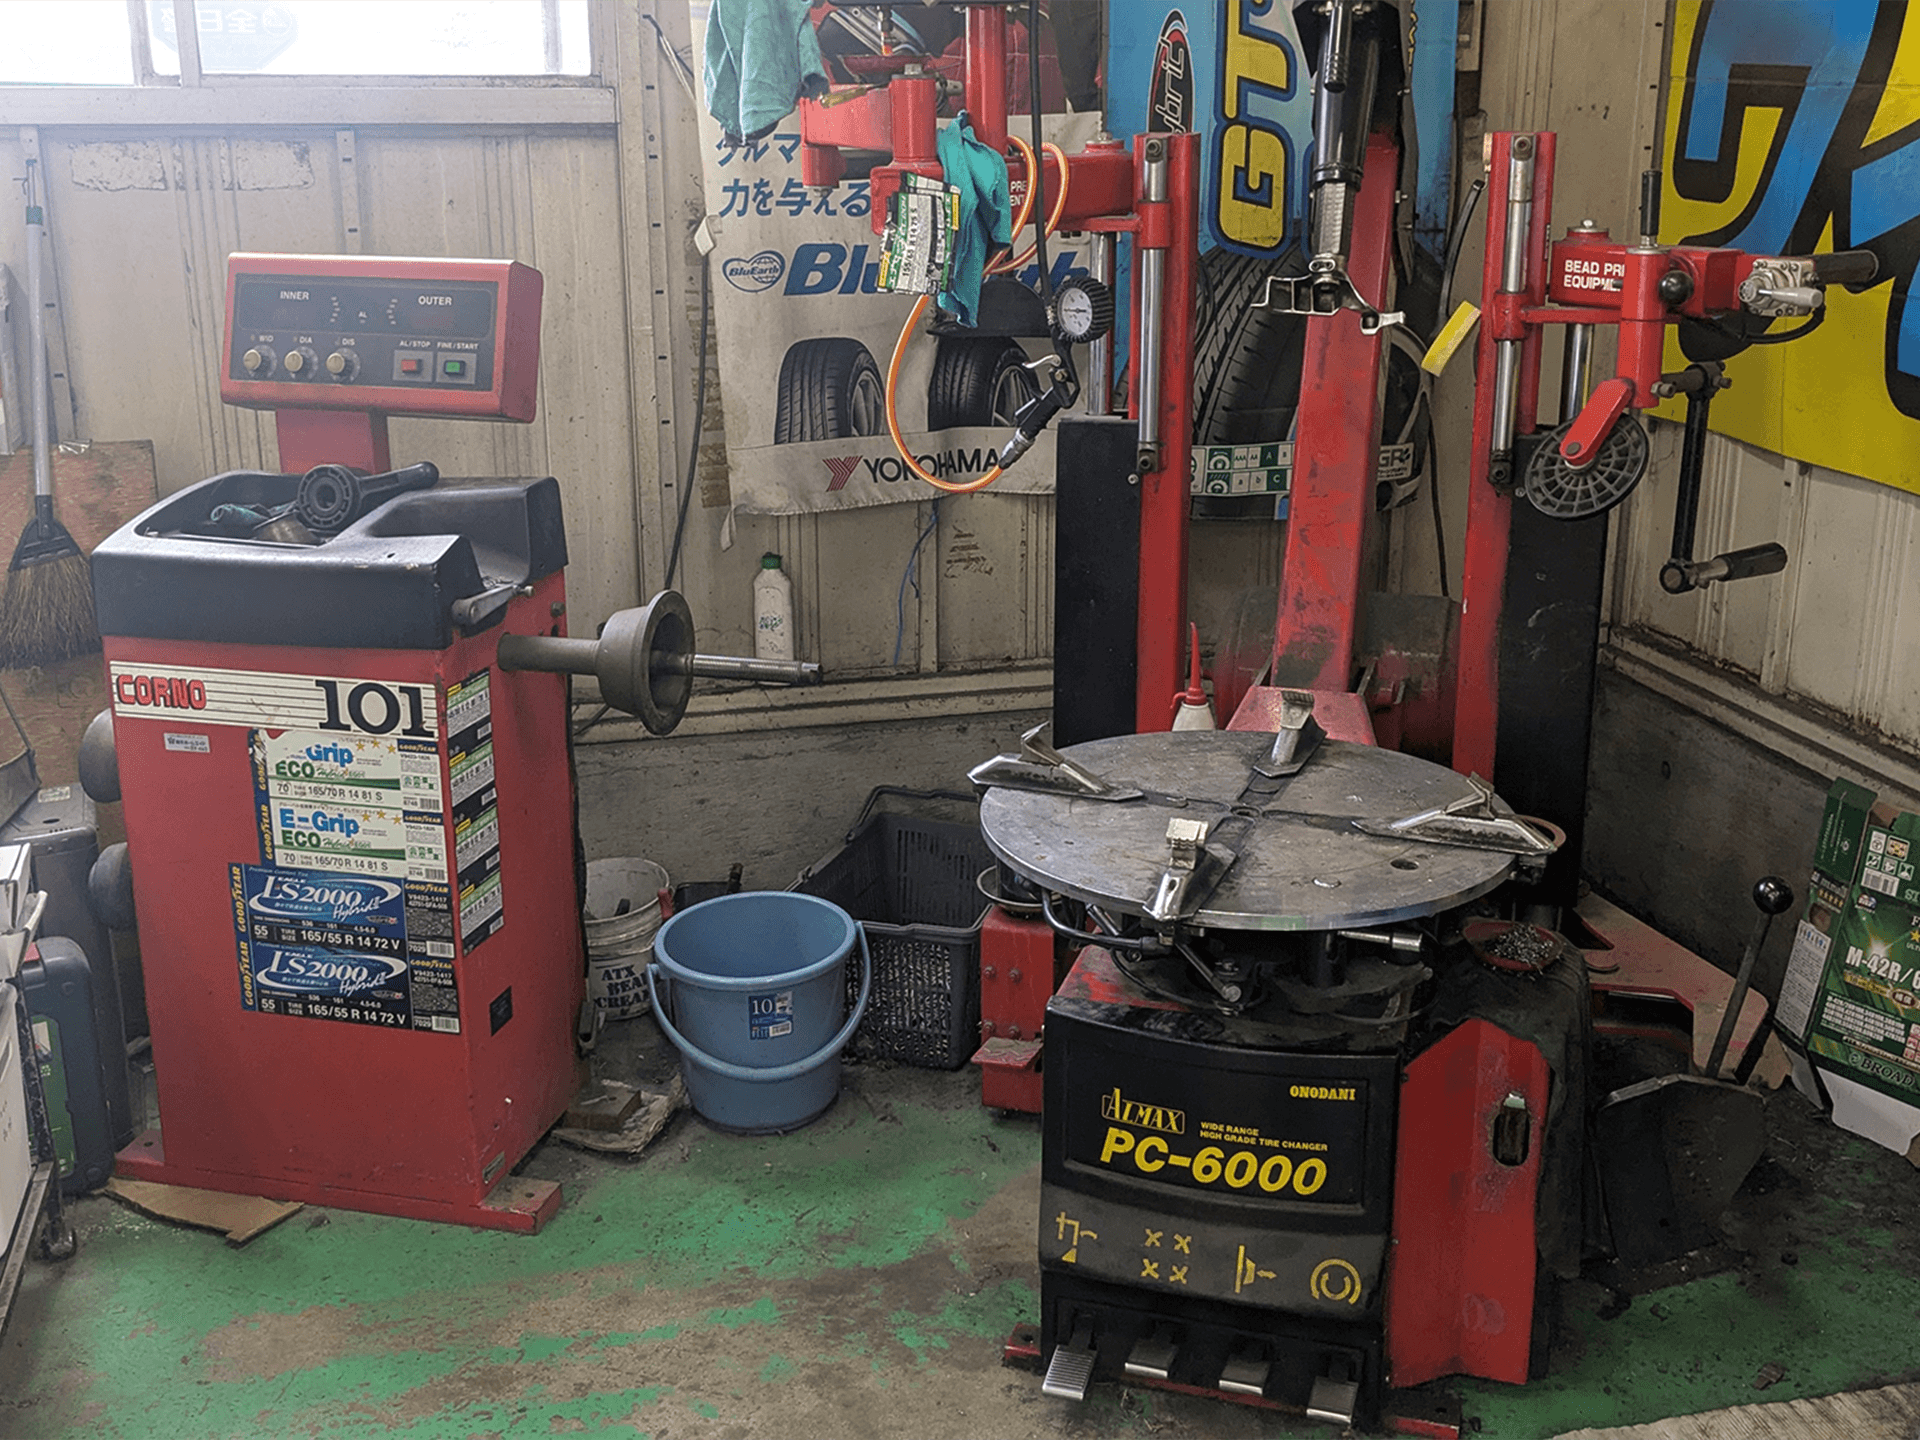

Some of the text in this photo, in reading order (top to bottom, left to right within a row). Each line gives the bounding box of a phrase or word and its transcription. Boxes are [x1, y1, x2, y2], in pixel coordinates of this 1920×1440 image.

[719, 177, 871, 218] 力を与える
[728, 264, 780, 277] BluEarth
[1565, 259, 1600, 274] BEAD
[280, 291, 310, 300] INNER
[418, 296, 452, 306] OUTER
[342, 338, 355, 346] DIS
[437, 342, 479, 350] FINE/START
[863, 448, 1000, 483] YOKOHAMA
[117, 674, 207, 710] CORNO
[315, 679, 435, 738] 101
[275, 760, 315, 778] ECO
[277, 783, 289, 792] 70
[308, 786, 338, 797] 165/70
[349, 790, 359, 799] 14
[362, 791, 372, 800] 81
[375, 792, 383, 801] S
[260, 804, 273, 860] GOODYEAR
[281, 829, 321, 848] ECO
[284, 853, 296, 863] 70
[314, 856, 344, 867] 165/70
[355, 859, 365, 869] 14
[367, 860, 378, 870] 81
[381, 861, 388, 871] S
[277, 876, 306, 884] EAGLE
[404, 883, 449, 893] GOODYEAR
[261, 875, 363, 906] LS2000
[231, 866, 246, 932] GOODYEAR
[254, 925, 268, 936] 55
[301, 930, 400, 950] 165/55 R 14 72 V
[284, 951, 313, 959] EAGLE
[269, 950, 369, 982] LS2000
[410, 959, 452, 969] GOODYEAR
[239, 941, 254, 1006] GOODYEAR
[602, 965, 636, 981] ATX
[261, 999, 276, 1010] 55
[753, 999, 773, 1014] 10
[307, 1004, 406, 1024] 165/55 R 14 72 V
[1861, 1057, 1915, 1087] BROAD
[1289, 1085, 1356, 1101] ONODANI
[1105, 1087, 1184, 1133] ALMAX
[1201, 1121, 1260, 1137] WIDE RANGE
[1200, 1130, 1328, 1151] HIGH GRADE TIRE CHANGER
[1100, 1126, 1328, 1196] PC-6000
